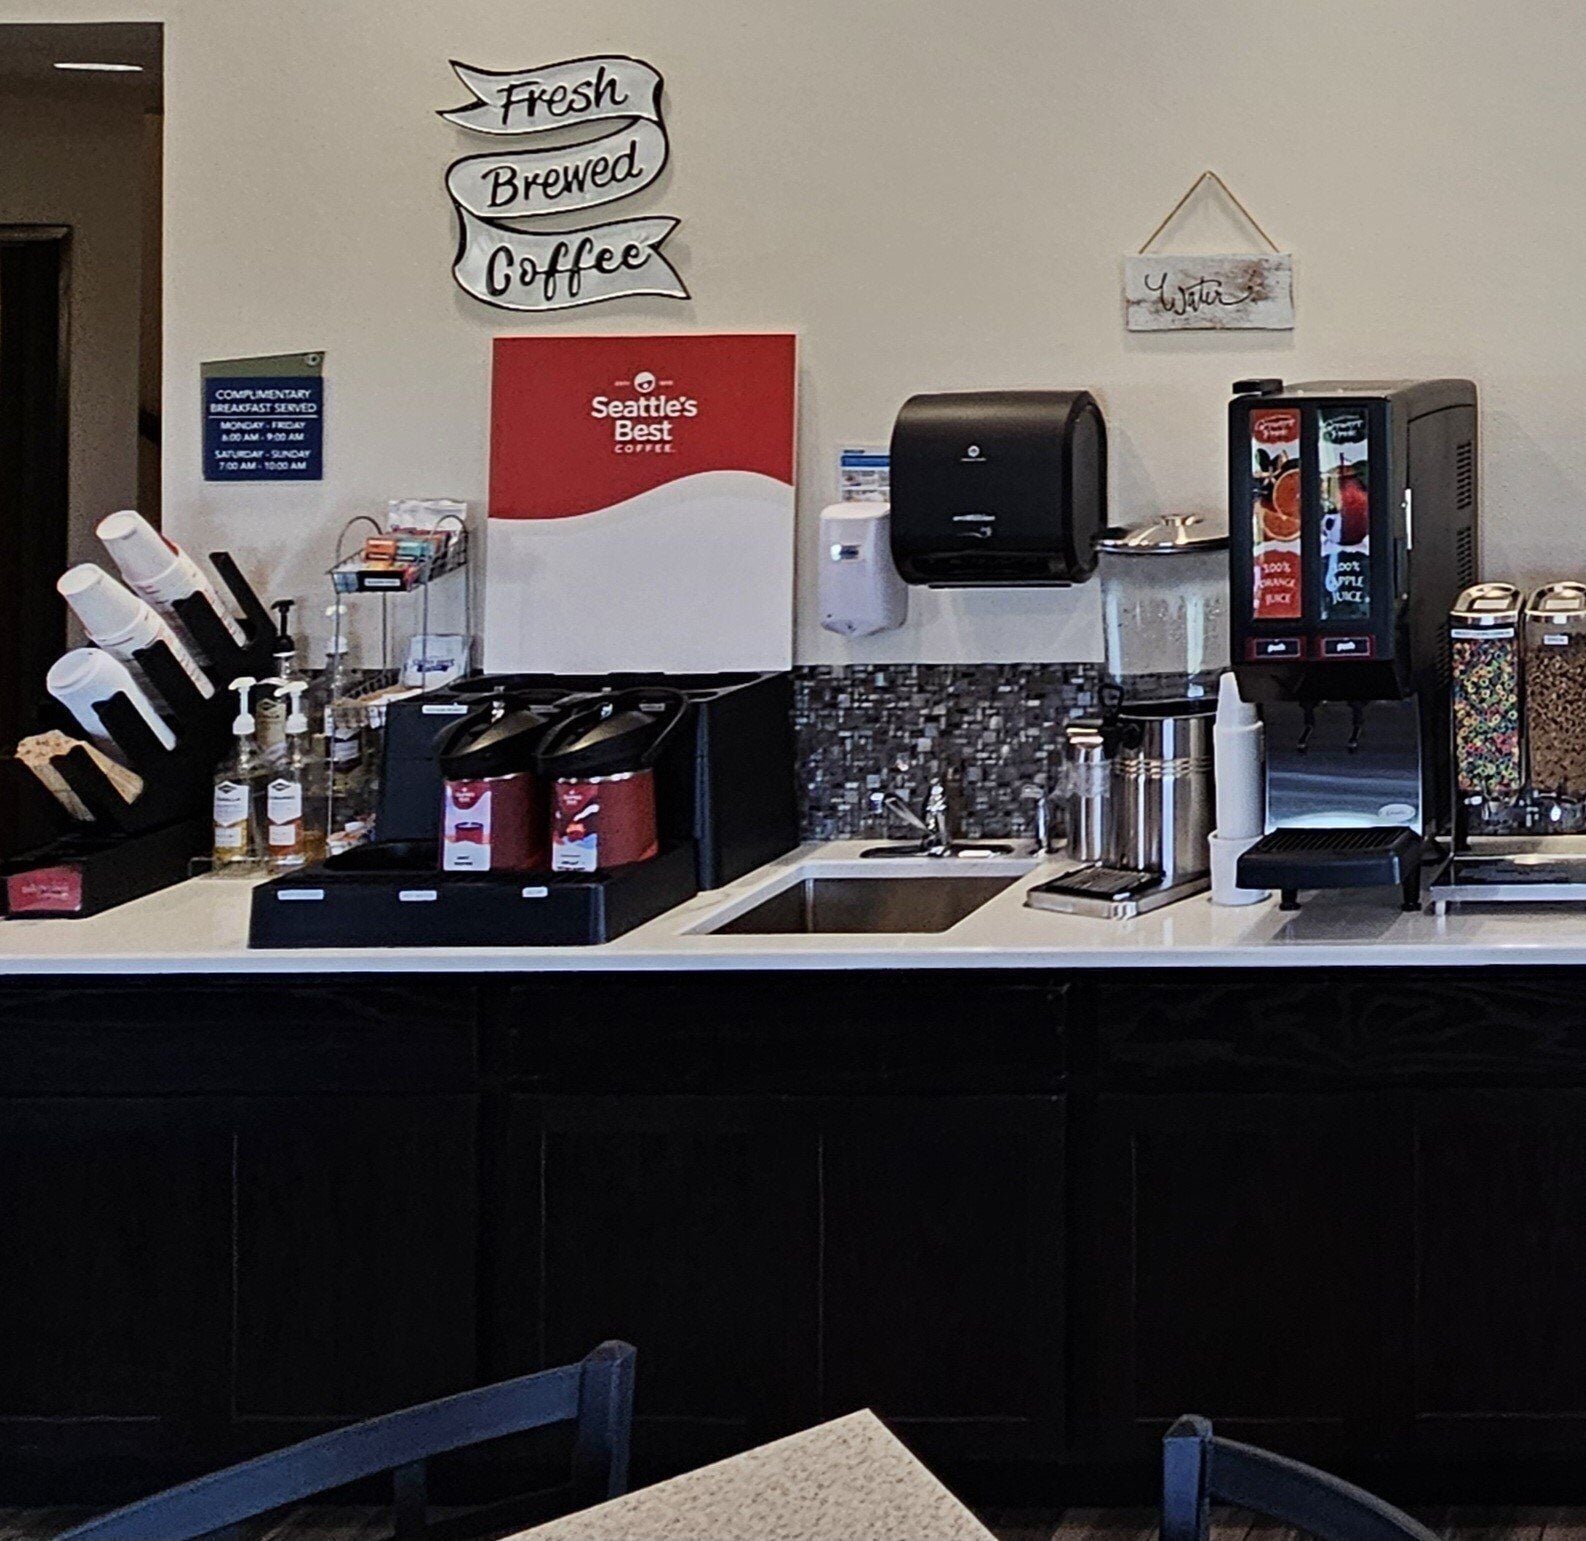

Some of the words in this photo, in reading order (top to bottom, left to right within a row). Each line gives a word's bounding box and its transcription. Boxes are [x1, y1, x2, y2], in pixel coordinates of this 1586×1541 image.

[497, 65, 629, 125] Fresh
[481, 139, 643, 207] Brewed
[485, 237, 652, 301] Coffee
[1144, 272, 1253, 316] Water
[215, 389, 312, 400] COMPLIMENTARY
[210, 403, 273, 413] BREAKFAST
[274, 403, 317, 413] SERVED
[591, 395, 698, 418] Seattle's
[220, 421, 265, 430] MONDAY
[271, 421, 306, 430] FRIDAY
[614, 420, 673, 441] Best
[243, 433, 259, 441] AM
[266, 432, 286, 441] 9:00
[288, 432, 304, 441] AM
[215, 450, 264, 459] SATURDAY
[271, 450, 311, 458] SUNDAY
[219, 462, 239, 470] 7:00
[240, 462, 257, 470] AM
[264, 462, 288, 470] 10:00
[290, 462, 307, 470] AM
[1263, 562, 1291, 573] 100%
[1260, 577, 1296, 589] ORANGE
[1265, 593, 1292, 606] JUICE
[1332, 591, 1363, 605] JUICE
